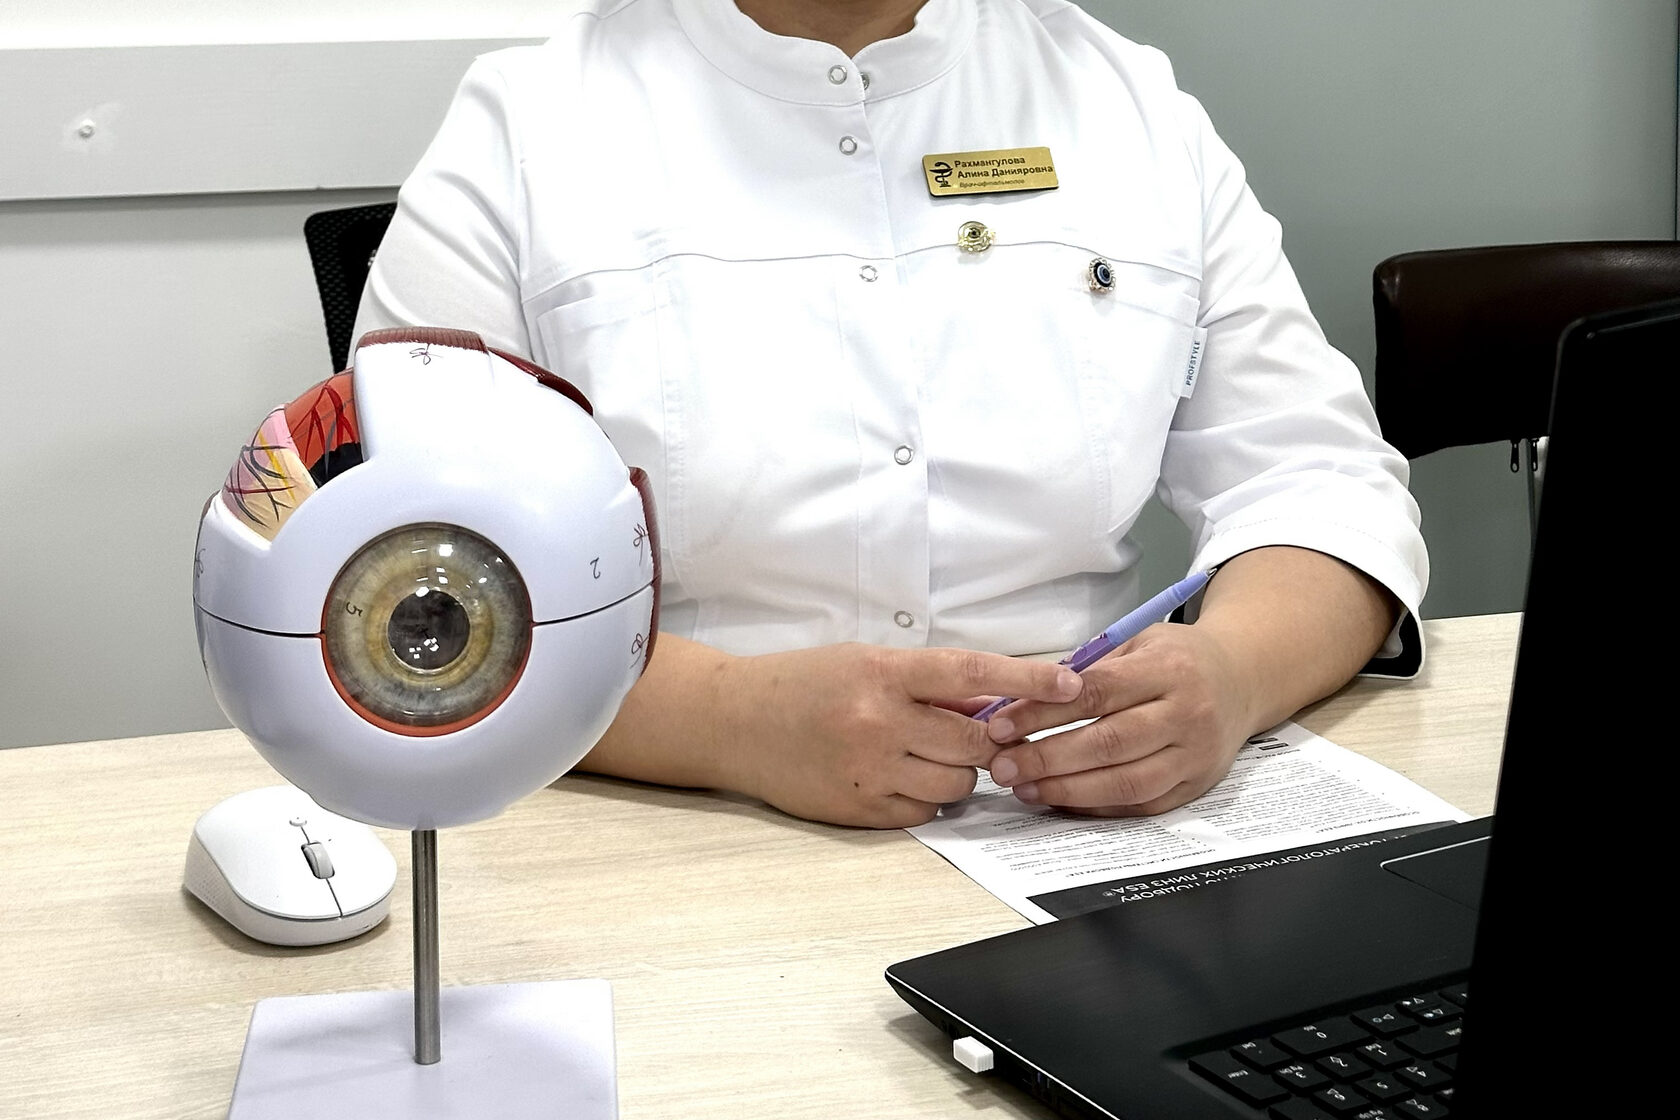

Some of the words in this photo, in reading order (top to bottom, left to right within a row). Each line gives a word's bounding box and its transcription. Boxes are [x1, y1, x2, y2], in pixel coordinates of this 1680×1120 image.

[954, 157, 1025, 168] Рахмангулова
[957, 169, 989, 179] Алина
[991, 165, 1053, 177] Данияровна
[1151, 874, 1198, 887] ЛИНЗ
